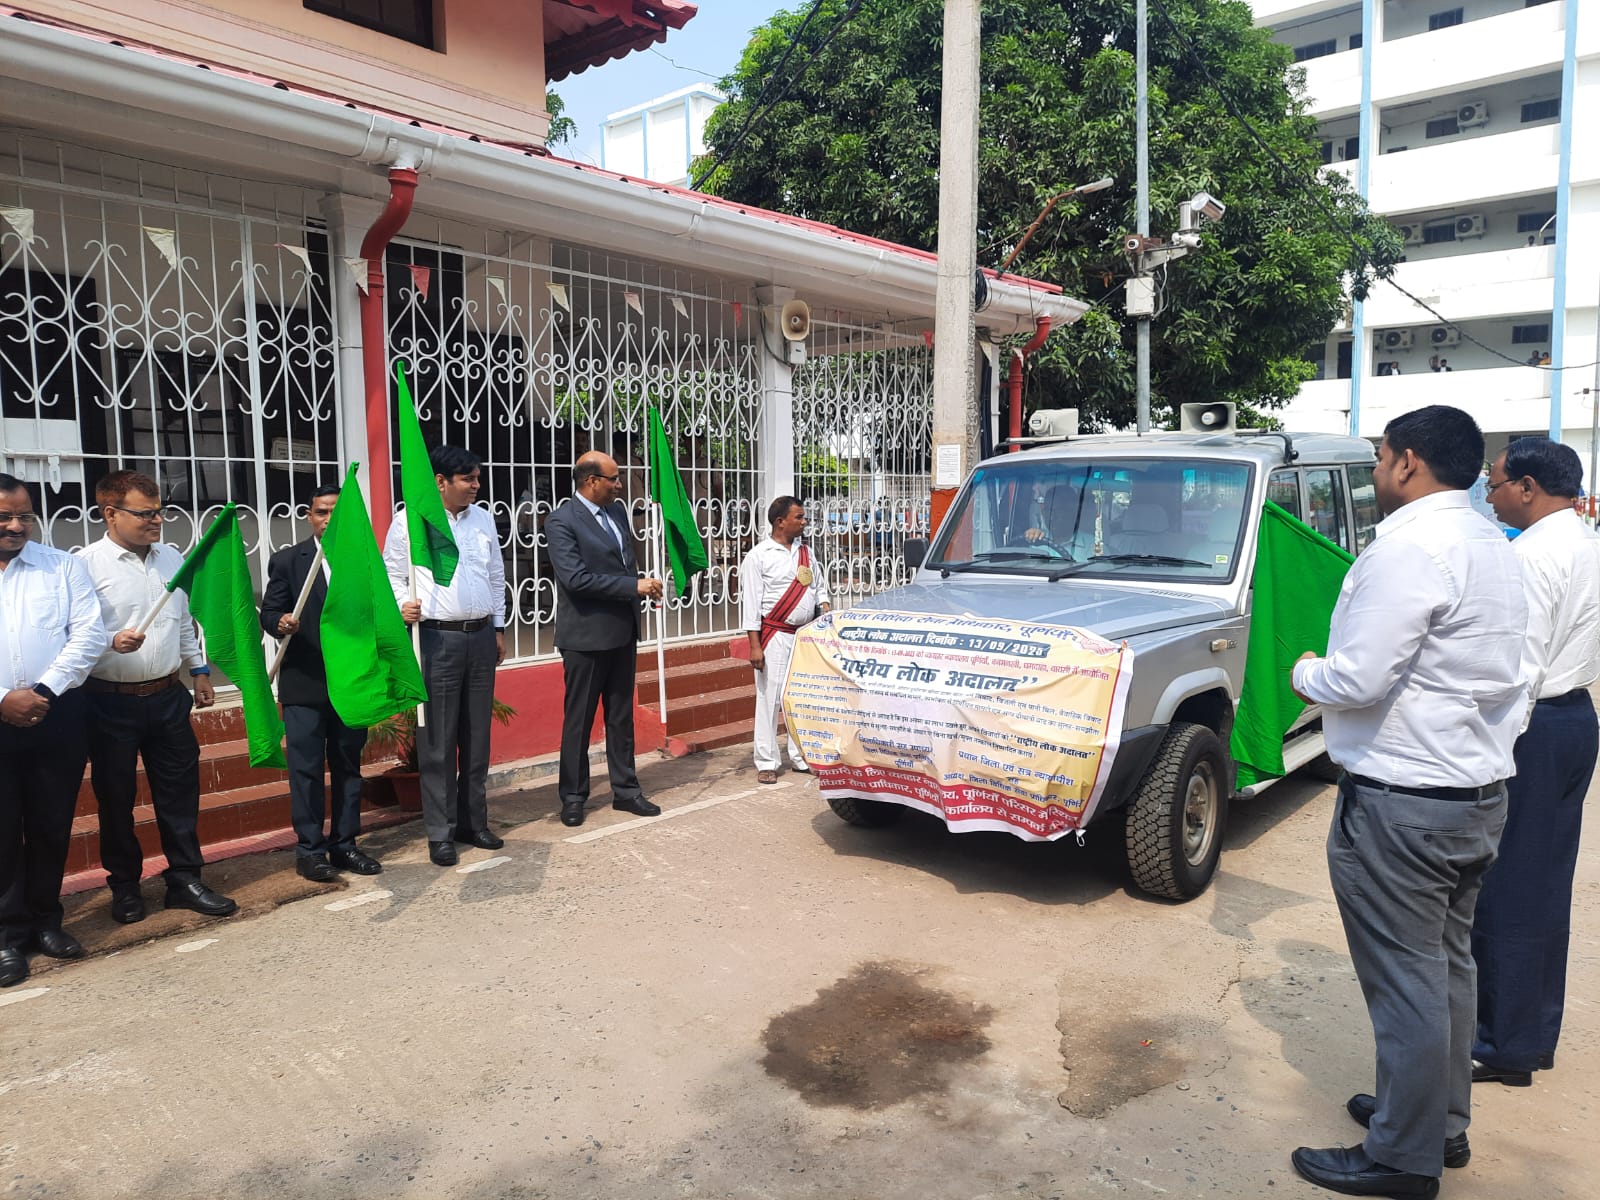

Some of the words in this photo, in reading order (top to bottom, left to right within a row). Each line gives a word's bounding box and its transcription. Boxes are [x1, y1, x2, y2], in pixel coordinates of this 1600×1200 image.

[868, 630, 889, 641] लोक
[890, 632, 924, 643] अदालत
[925, 633, 959, 646] दिनांक
[896, 661, 940, 683] लोक
[1040, 742, 1058, 752] लोक
[958, 750, 978, 763] प्रधान
[980, 754, 1000, 769] जिला
[1018, 766, 1032, 777] सत्र
[1034, 770, 1074, 786] न्यायाधीश
[945, 802, 994, 815] कार्यालय
[996, 806, 1008, 818] से
